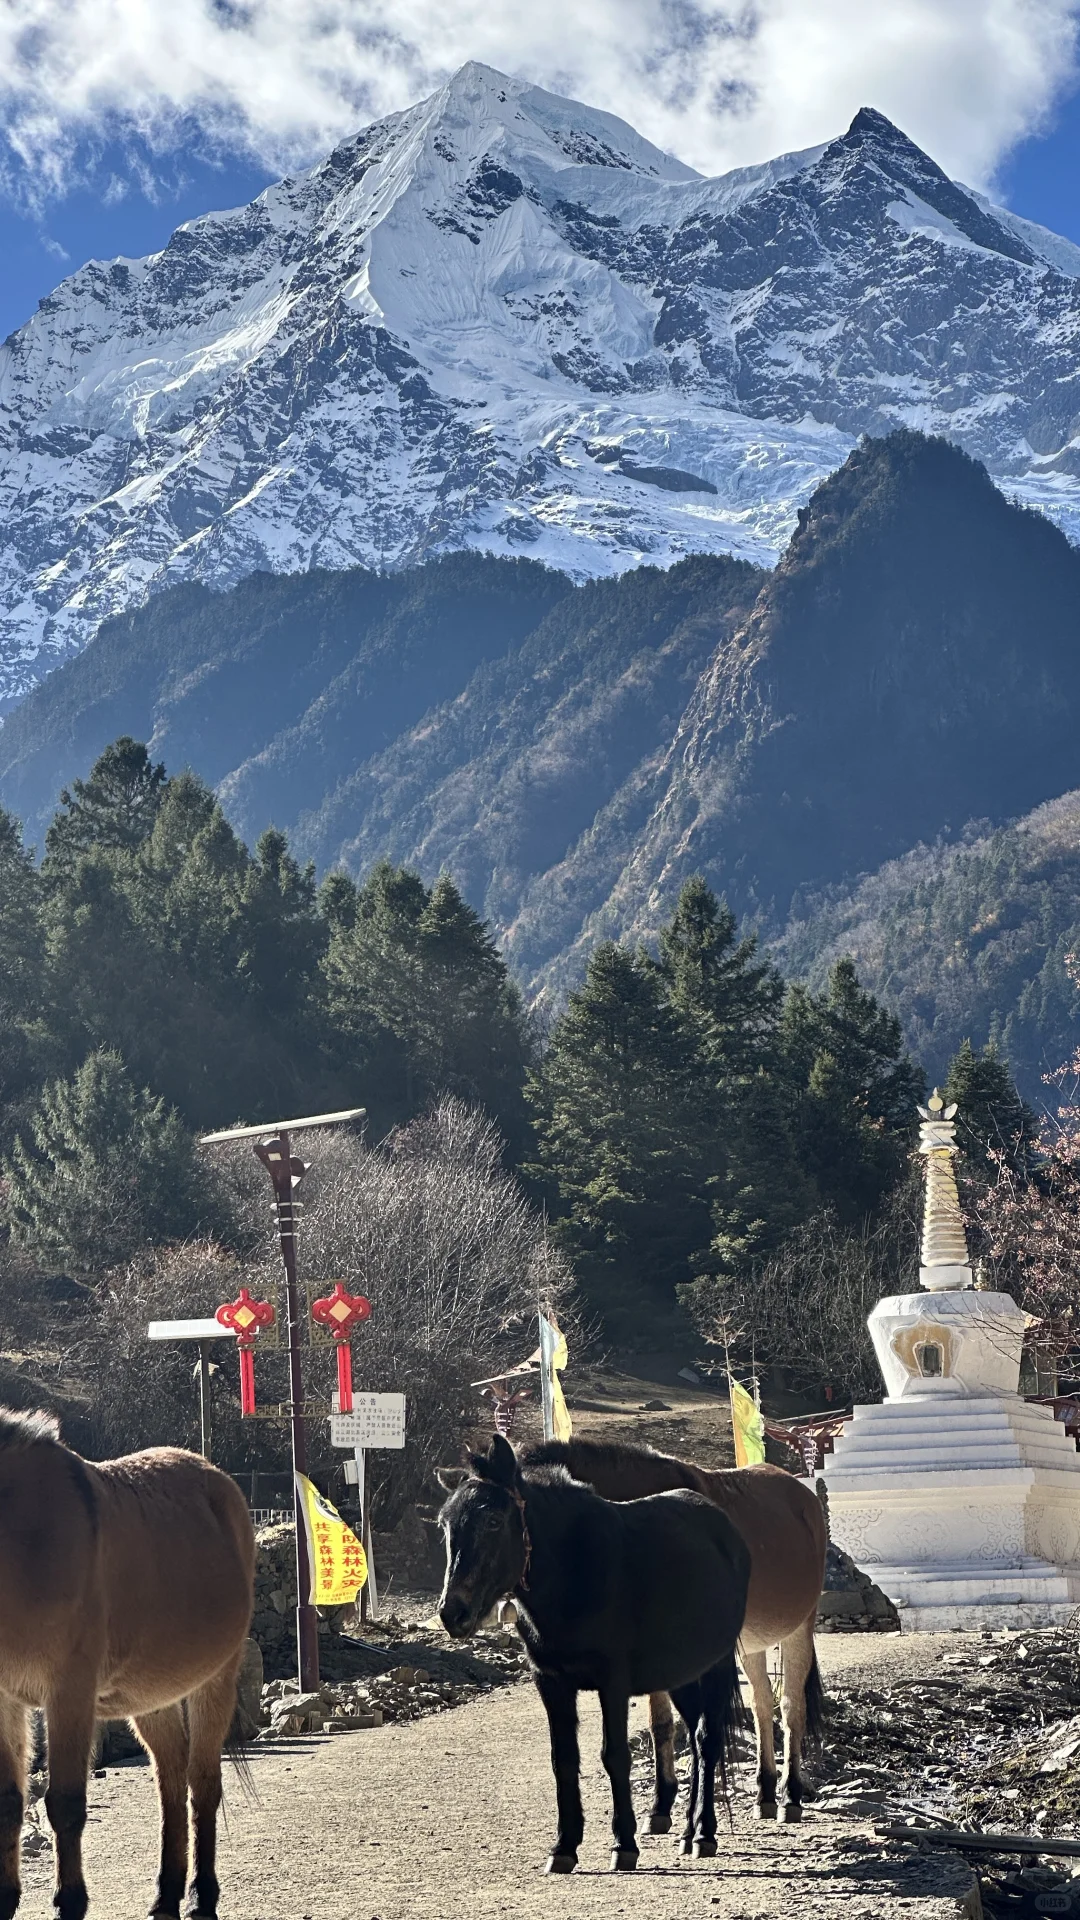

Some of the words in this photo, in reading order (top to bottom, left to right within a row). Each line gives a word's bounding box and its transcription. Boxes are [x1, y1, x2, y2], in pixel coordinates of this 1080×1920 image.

[359, 1397, 377, 1406] 公告
[314, 1522, 335, 1590] 共享森林美景
